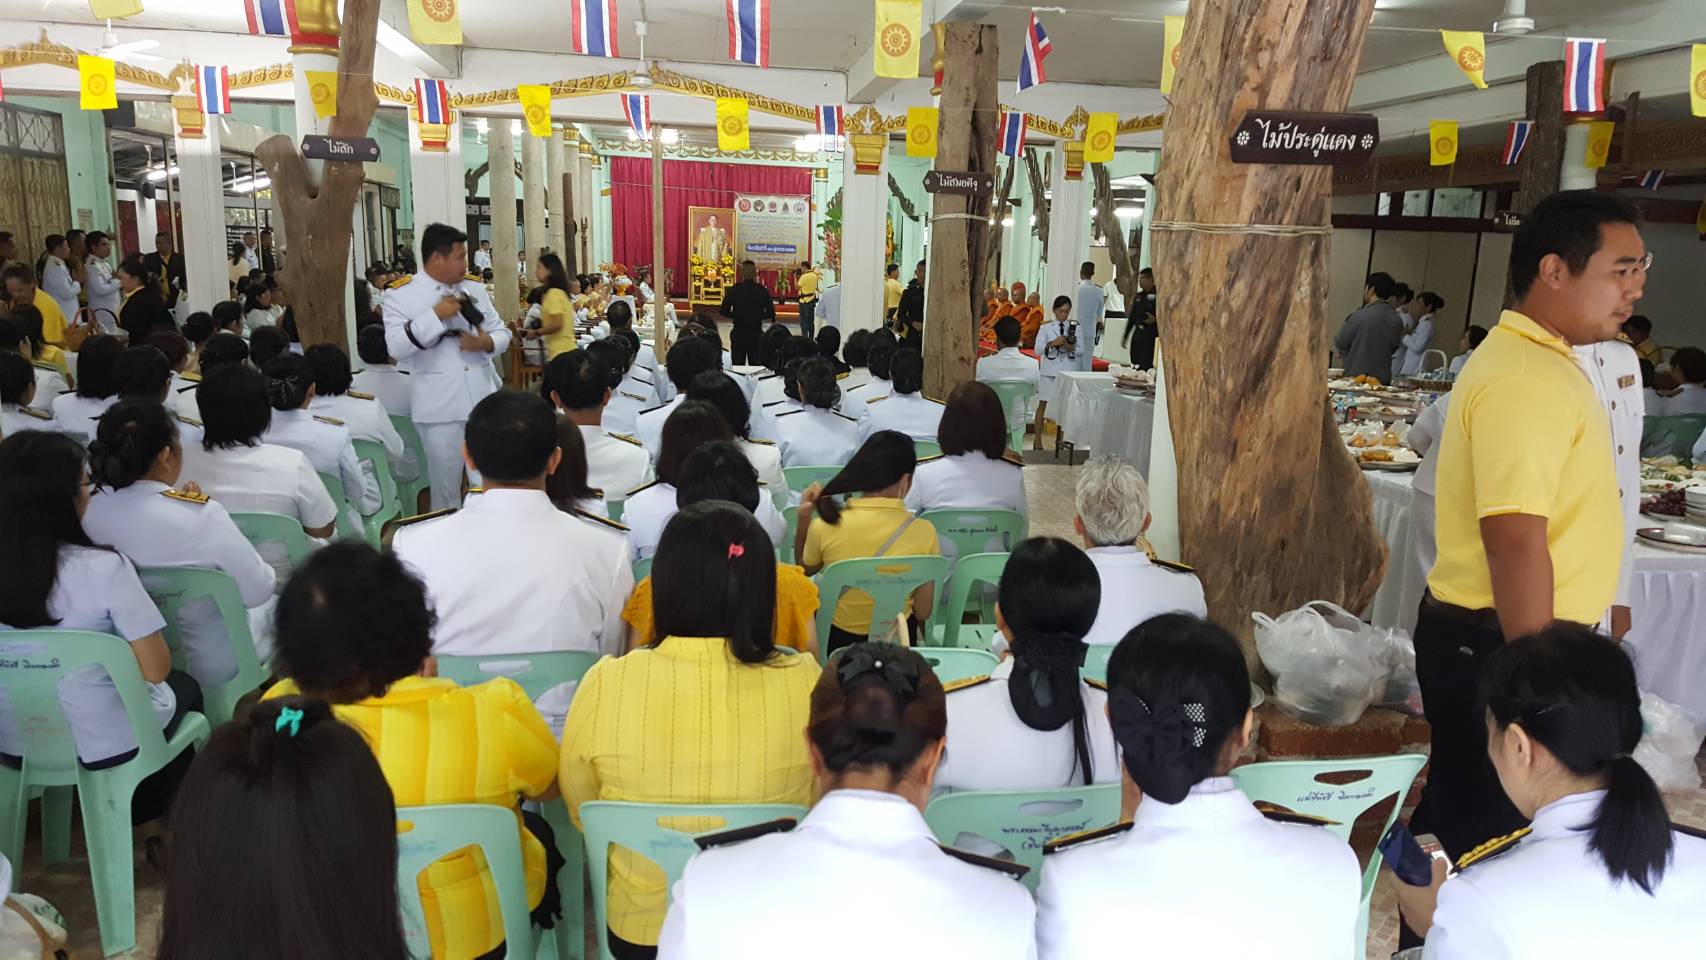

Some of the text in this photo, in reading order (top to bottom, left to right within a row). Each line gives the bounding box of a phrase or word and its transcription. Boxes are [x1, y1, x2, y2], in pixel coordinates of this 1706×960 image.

[323, 138, 354, 155] ไม้สัก
[1256, 118, 1357, 158] ไม้ประดู่แดง
